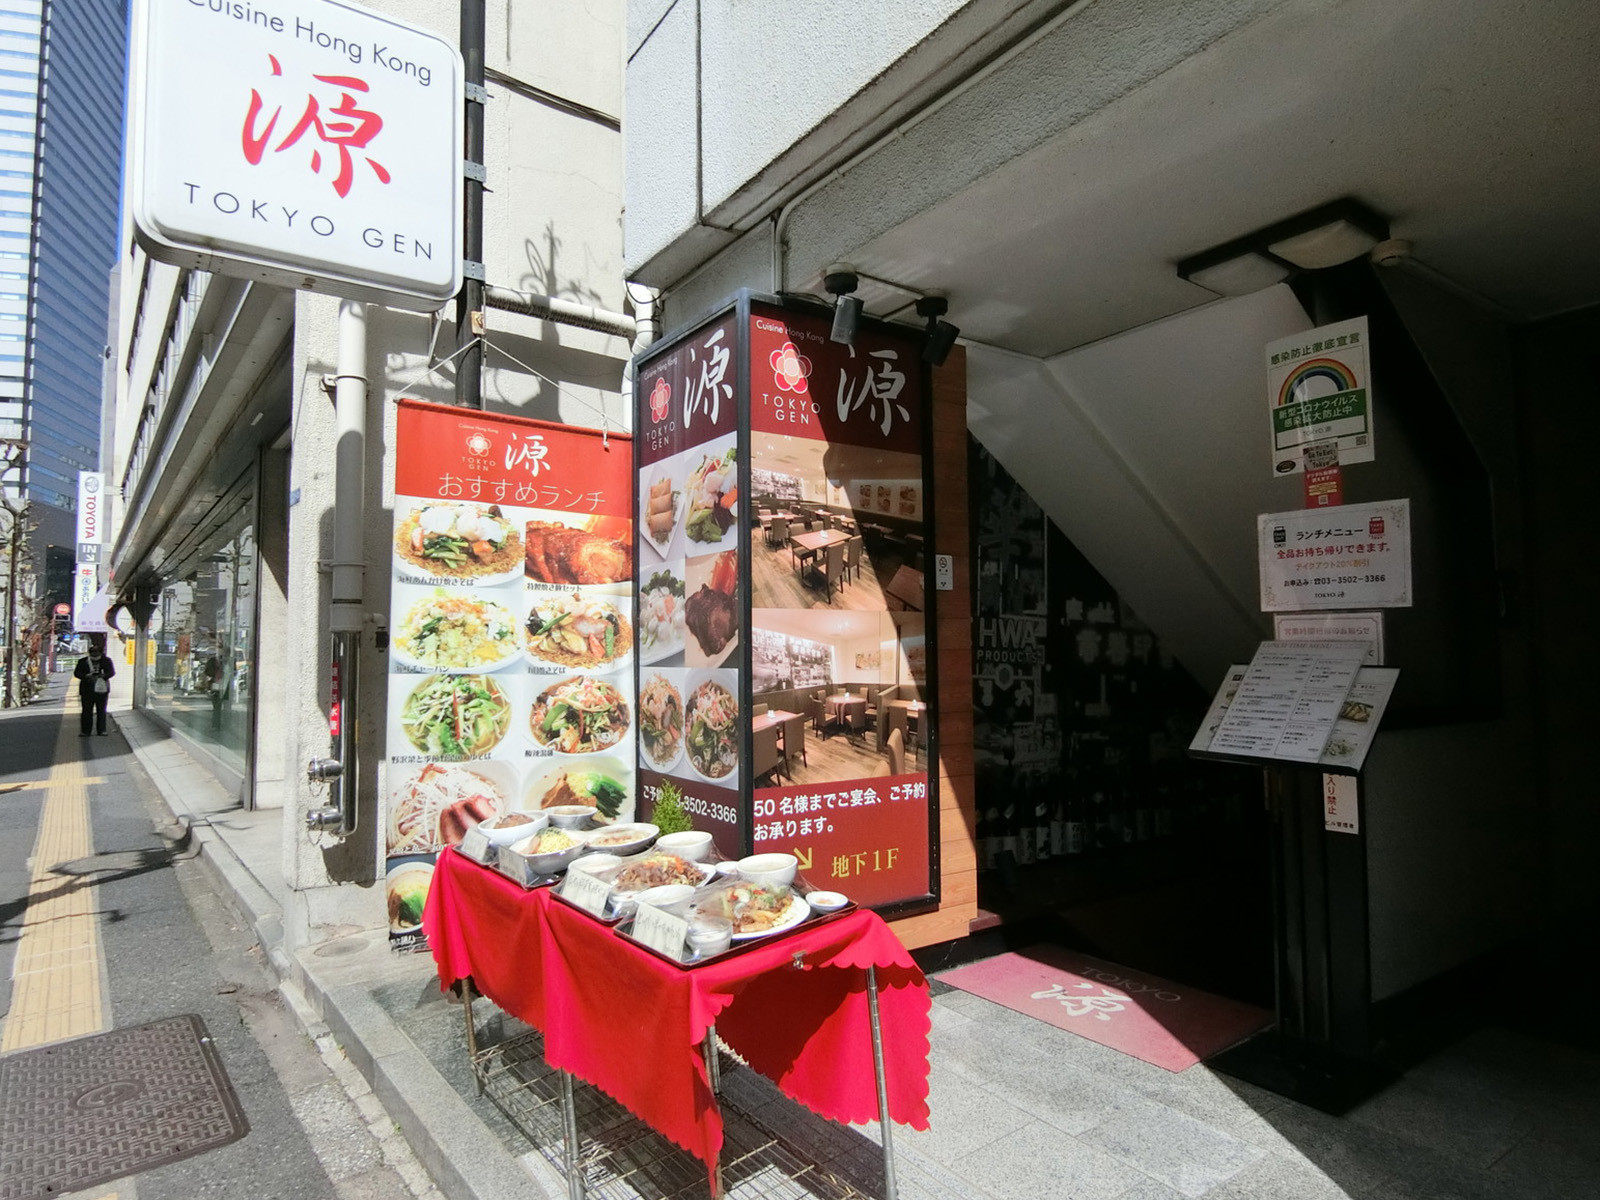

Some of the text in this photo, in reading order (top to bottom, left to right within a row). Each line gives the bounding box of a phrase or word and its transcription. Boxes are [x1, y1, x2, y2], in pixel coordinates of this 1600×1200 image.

[187, 0, 431, 86] uisine Hong Kong
[242, 53, 391, 199] 源
[184, 182, 432, 260] TOKYO GEN
[756, 320, 824, 344] Cuisine Hong Kong
[1271, 332, 1360, 365] 感染防止徹底宣言
[683, 328, 733, 429] 源
[837, 344, 910, 437] 源
[762, 393, 821, 414] TOKYO
[1279, 394, 1358, 419] 新型コロナウイルス
[775, 410, 809, 424] GEN
[646, 421, 676, 442] TOKYO
[651, 437, 669, 451] GEN
[461, 457, 496, 466] TOKYO
[504, 432, 551, 477] 源
[438, 473, 606, 512] おすすめランチ
[85, 495, 97, 539] TOYOTA
[1296, 529, 1364, 541] ランチメニュー
[82, 545, 97, 553] IN
[1277, 542, 1391, 560] 全品お持ち帰りできます。
[976, 650, 1037, 663] PRODUCTS
[754, 816, 835, 842] お承ります。
[1081, 966, 1181, 1001] TOKYO
